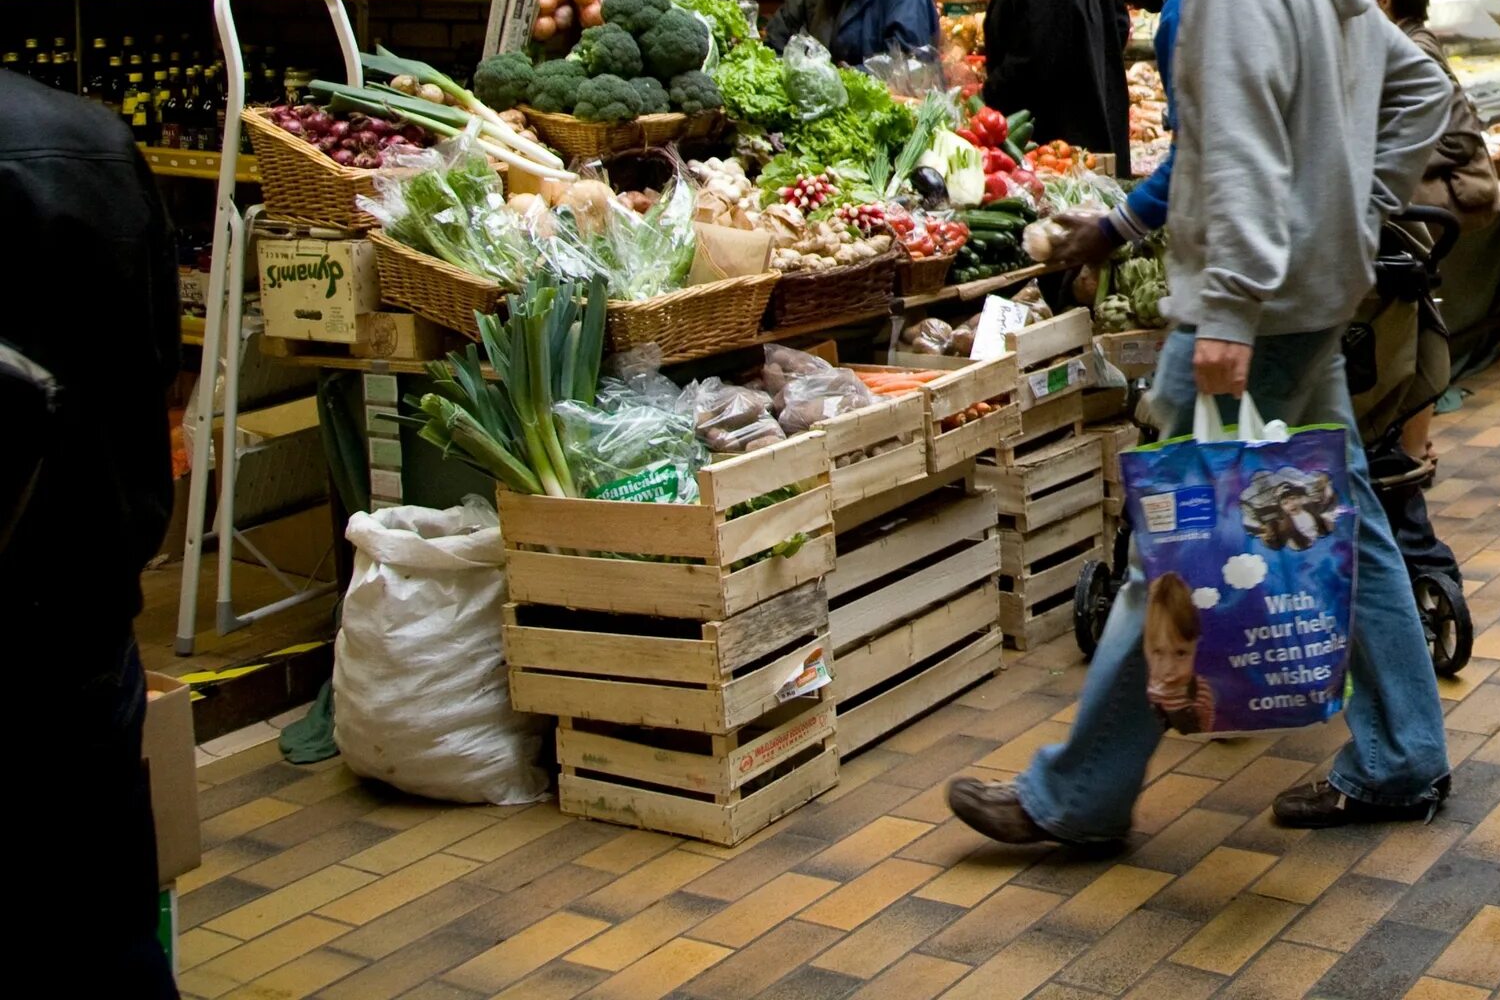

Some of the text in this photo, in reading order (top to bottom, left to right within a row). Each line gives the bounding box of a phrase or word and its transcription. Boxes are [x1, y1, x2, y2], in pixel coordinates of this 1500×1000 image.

[267, 254, 345, 299] dynamis
[619, 486, 665, 502] rown
[1264, 590, 1315, 615] With
[1243, 611, 1337, 647] your help
[1228, 632, 1347, 668] we can make
[1264, 663, 1333, 686] wishes
[1248, 693, 1308, 711] come
